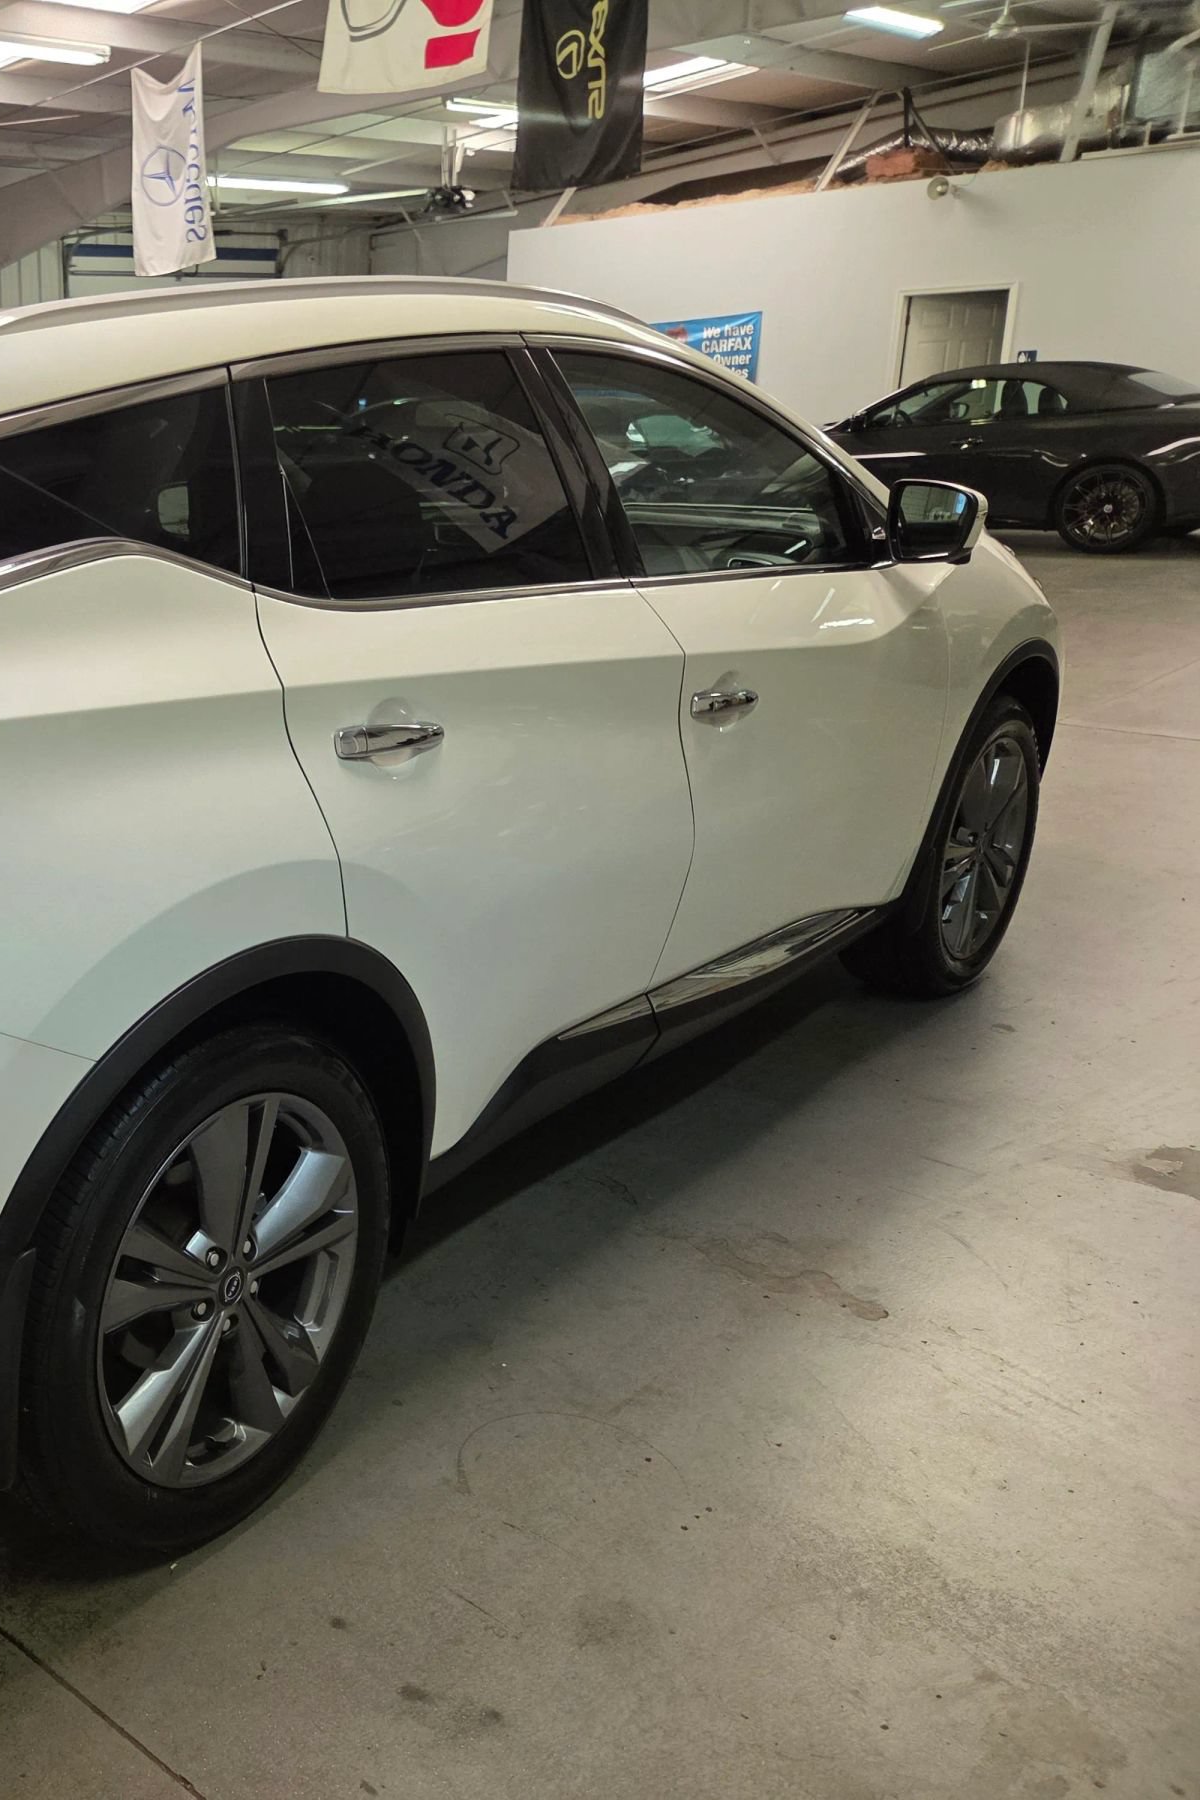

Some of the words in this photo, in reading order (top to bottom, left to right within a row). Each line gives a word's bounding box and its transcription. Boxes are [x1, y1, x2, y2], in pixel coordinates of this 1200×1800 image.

[703, 326, 721, 339] We
[724, 323, 754, 337] have
[702, 336, 752, 353] CARFAX
